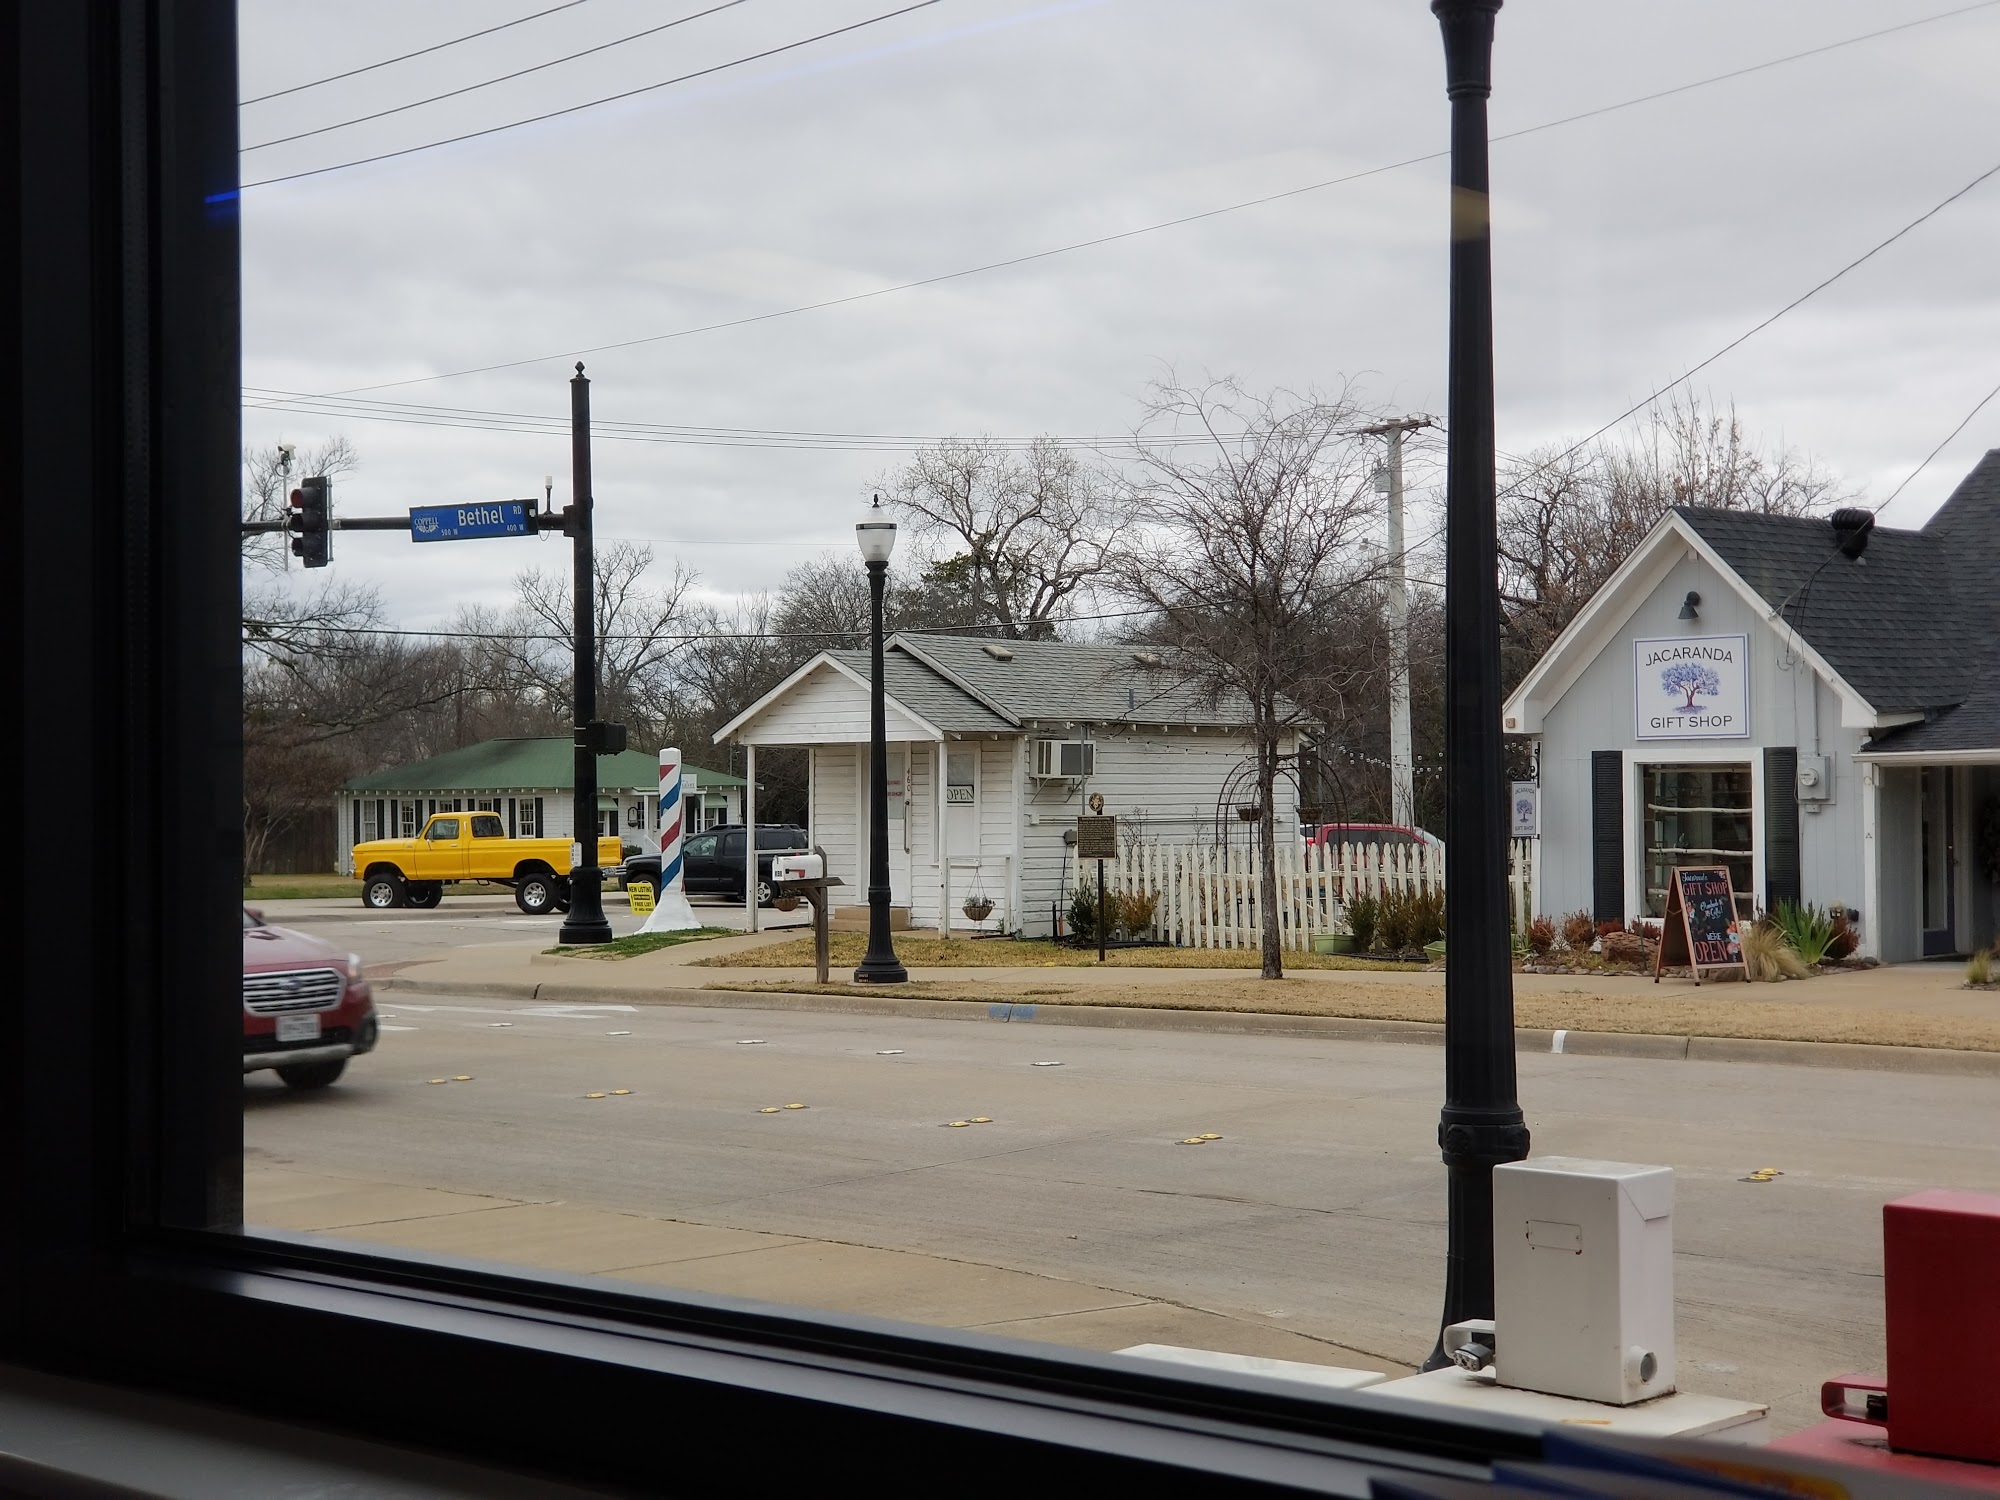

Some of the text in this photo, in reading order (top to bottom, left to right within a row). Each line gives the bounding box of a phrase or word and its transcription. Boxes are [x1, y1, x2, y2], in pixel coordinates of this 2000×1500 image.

[457, 505, 522, 527] Bethel RD
[441, 528, 452, 537] 500
[506, 522, 524, 532] 400 W
[1645, 646, 1733, 667] JACARANDA
[1650, 715, 1733, 729] GIFT SHOP
[946, 788, 975, 801] OPEN
[1683, 881, 1728, 895] GIFT SHOP
[1693, 940, 1729, 962] OPEN
